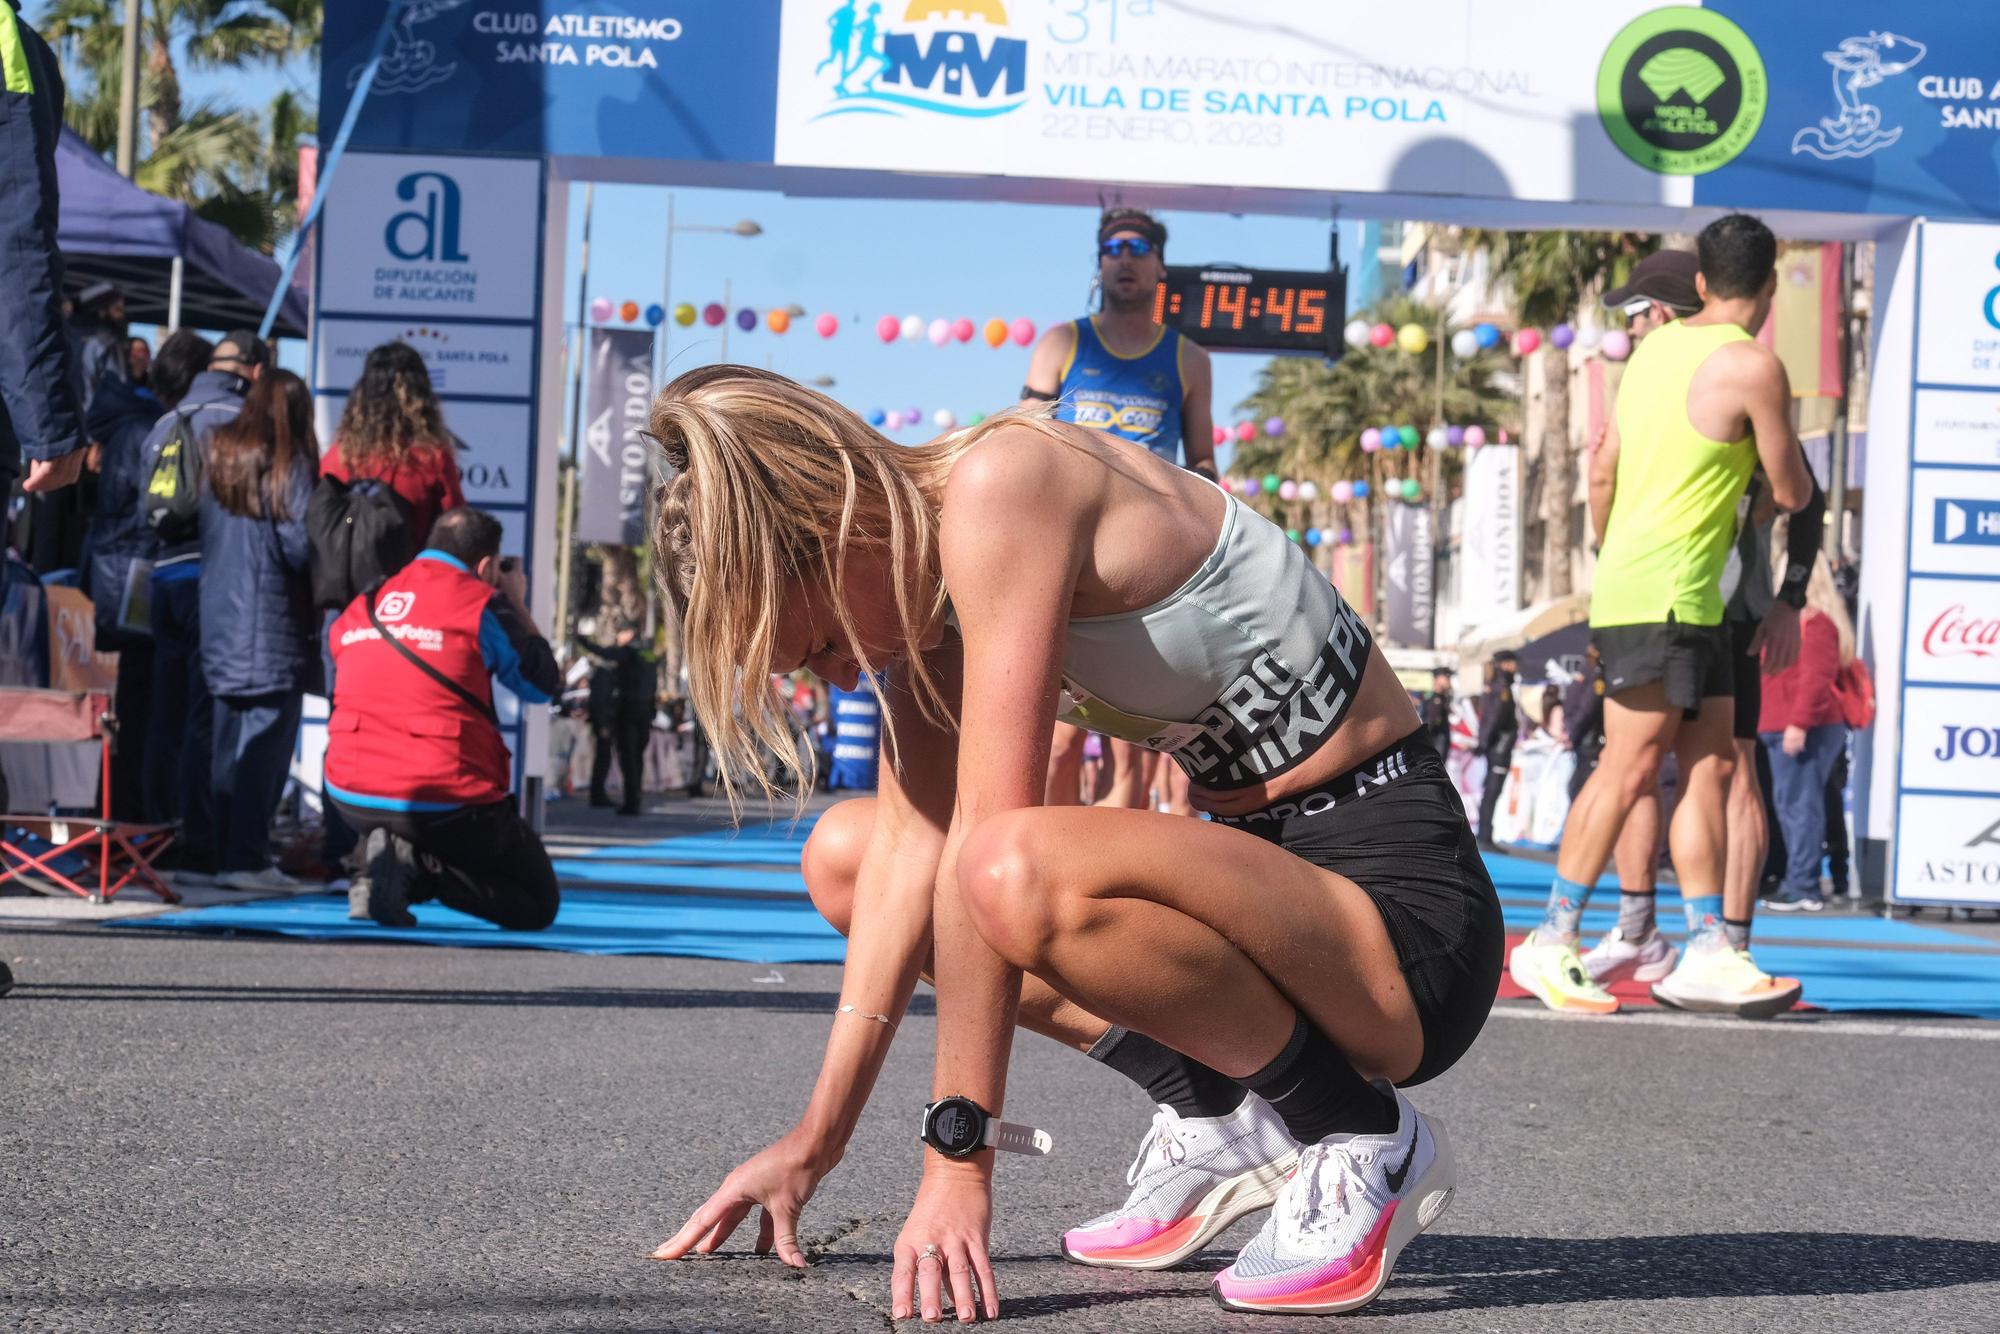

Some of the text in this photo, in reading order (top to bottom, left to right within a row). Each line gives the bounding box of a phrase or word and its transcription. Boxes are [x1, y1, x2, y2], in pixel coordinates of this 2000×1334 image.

[473, 12, 682, 41] CLUB ATLETISMO
[496, 41, 658, 69] SANTA POLA
[1043, 51, 1138, 80] MITJA
[1286, 61, 1541, 98] INTERNACIONAL
[1918, 75, 1983, 99] CLUB
[1043, 84, 1447, 124] VILA DE SANTA POLA
[1654, 105, 1707, 120] WORLD
[1041, 115, 1080, 139] 22
[1206, 121, 1284, 148] 2023
[1643, 119, 1718, 135] ATHLETICS
[374, 267, 477, 285] DIPUTACIÓN
[374, 286, 476, 303] DE ALICANTE
[1229, 655, 1347, 781] NIKE
